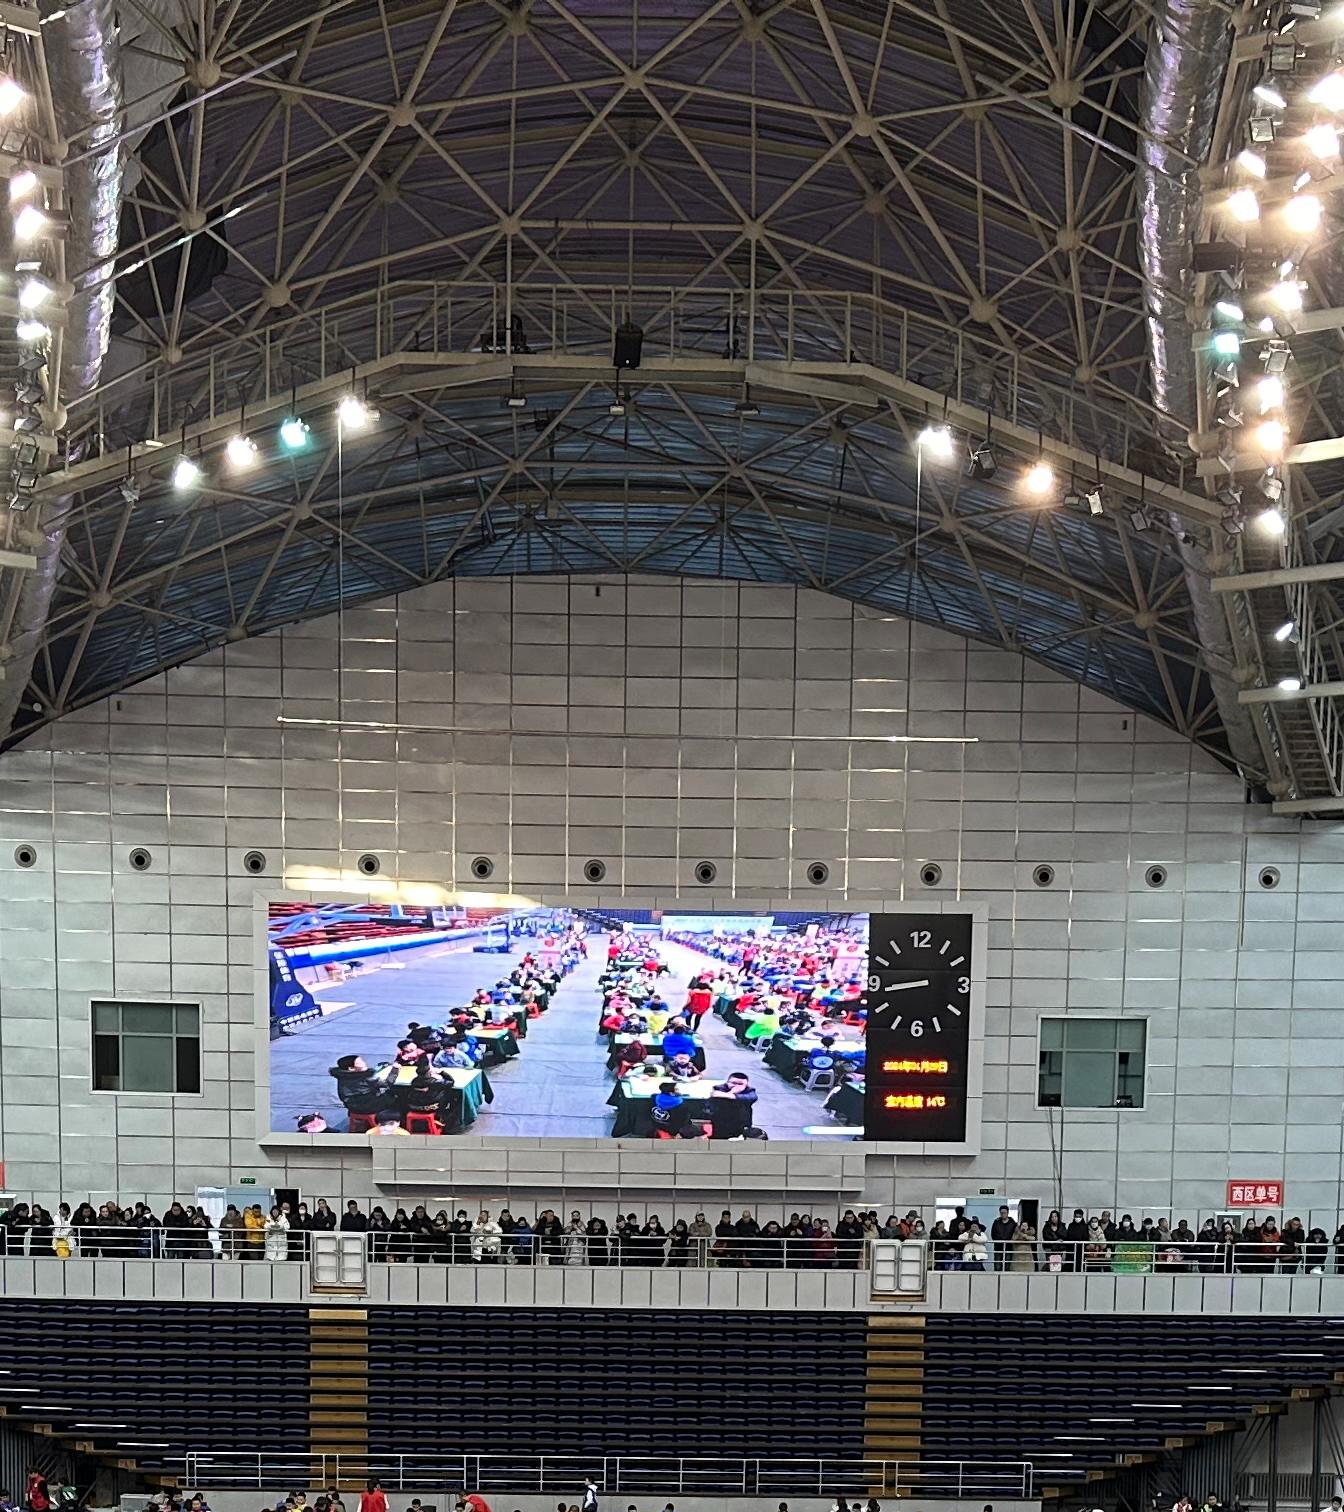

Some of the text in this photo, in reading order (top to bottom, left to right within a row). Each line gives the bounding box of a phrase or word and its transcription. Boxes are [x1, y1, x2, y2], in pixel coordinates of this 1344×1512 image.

[910, 931, 931, 948] 12
[868, 975, 881, 992] 9
[957, 976, 970, 994] 3
[910, 1020, 924, 1037] 6
[1231, 1185, 1279, 1202] 西区单号
